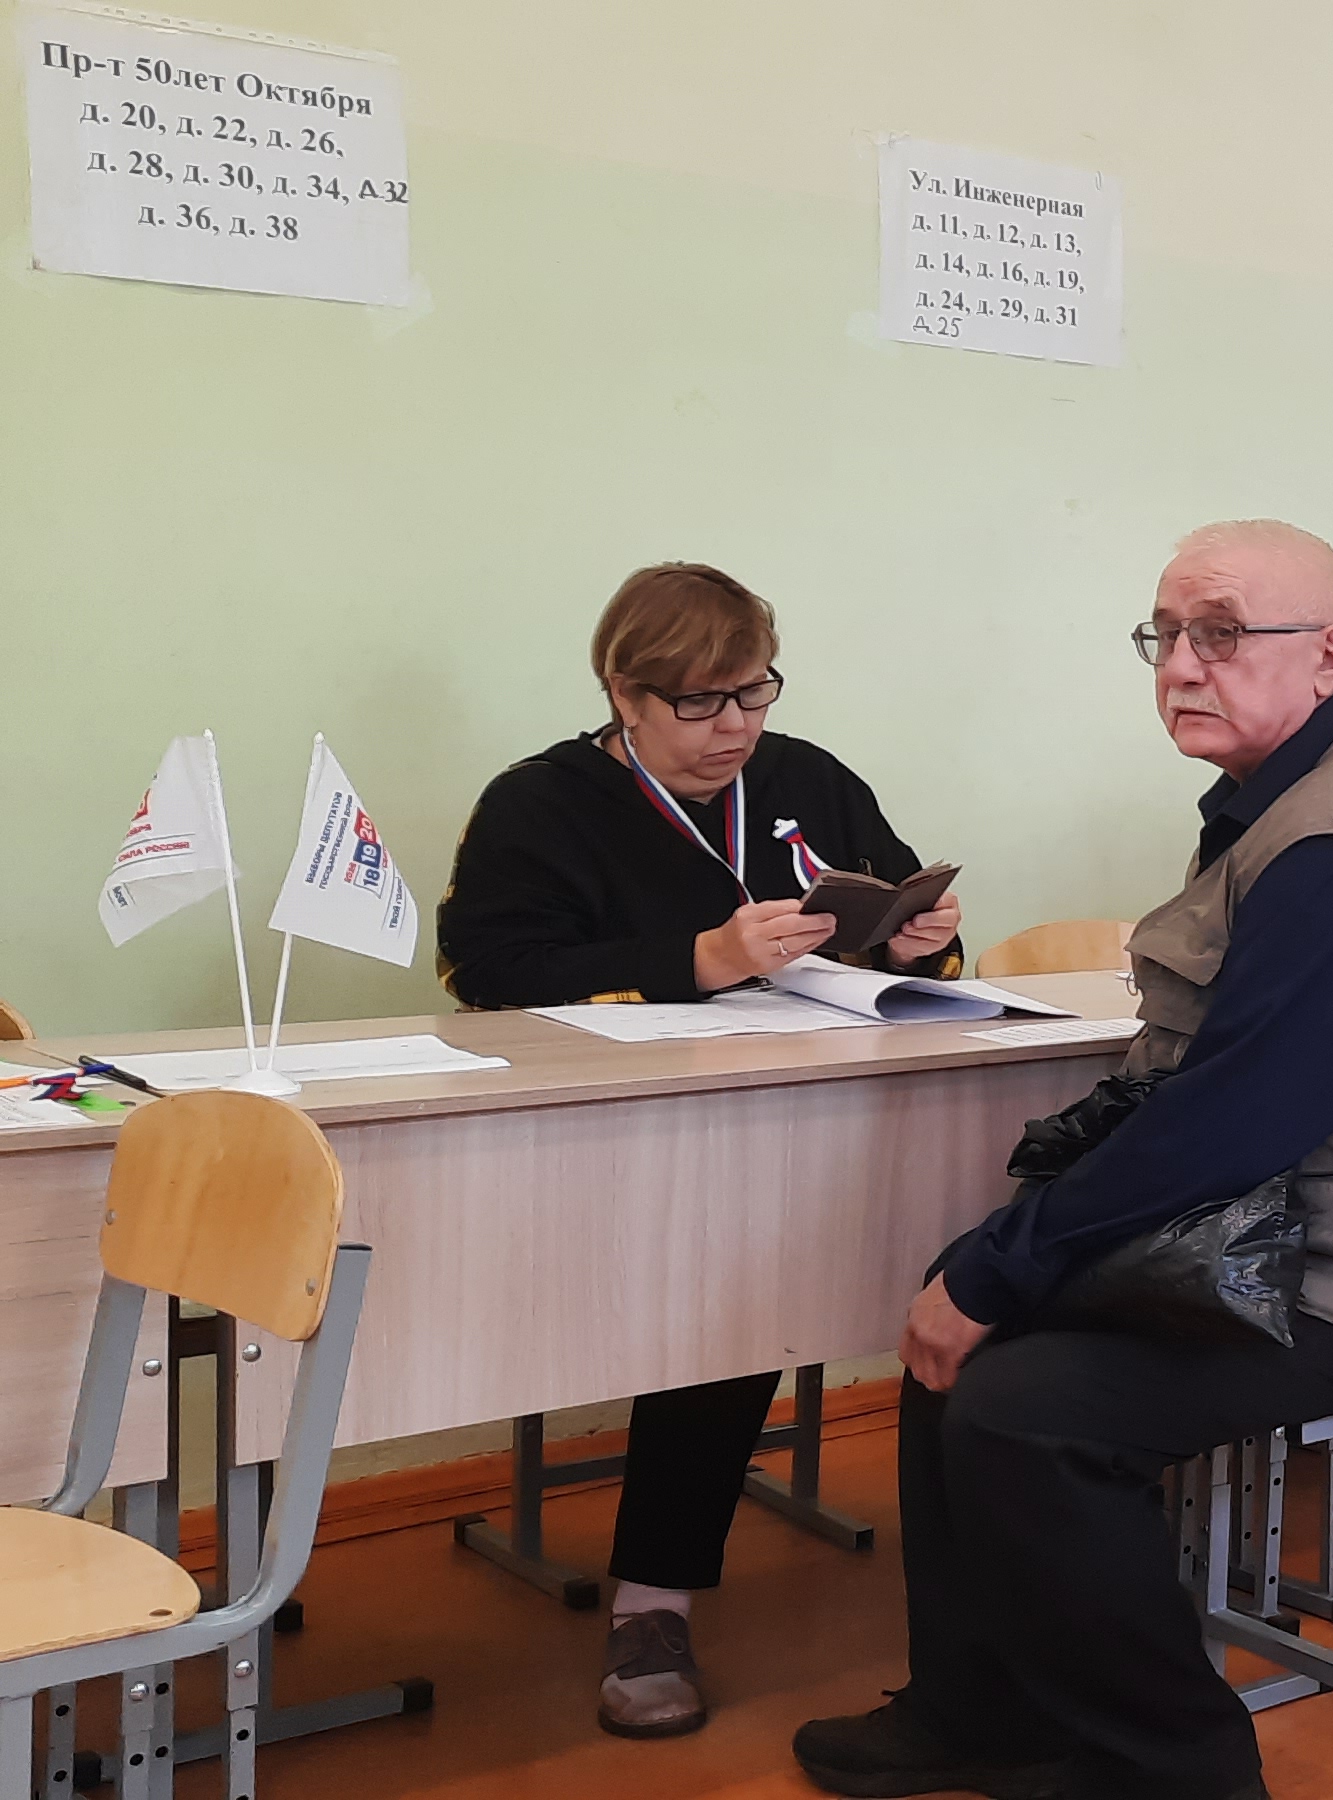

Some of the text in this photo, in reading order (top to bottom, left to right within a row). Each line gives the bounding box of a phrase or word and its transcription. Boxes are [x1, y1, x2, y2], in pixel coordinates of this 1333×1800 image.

[41, 41, 373, 118] Пр-т 50лет Октября
[80, 101, 345, 159] д. 20, д. 22, д. 26,
[87, 150, 350, 206] д. 28, д. 30, д. 34,
[909, 169, 1084, 219] Ул. Инженерная
[138, 203, 299, 242] д. 36, д. 38
[912, 214, 932, 232] д.
[940, 213, 968, 240] 11,
[999, 223, 1025, 249] 12,
[1030, 233, 1049, 250] д.
[1055, 232, 1082, 258] 13,
[915, 252, 1085, 295] д. 14, д. 16, д. 19,
[915, 289, 1077, 327] д. 24, д. 29, д. 31
[361, 844, 377, 863] 19
[363, 868, 381, 888] 18
